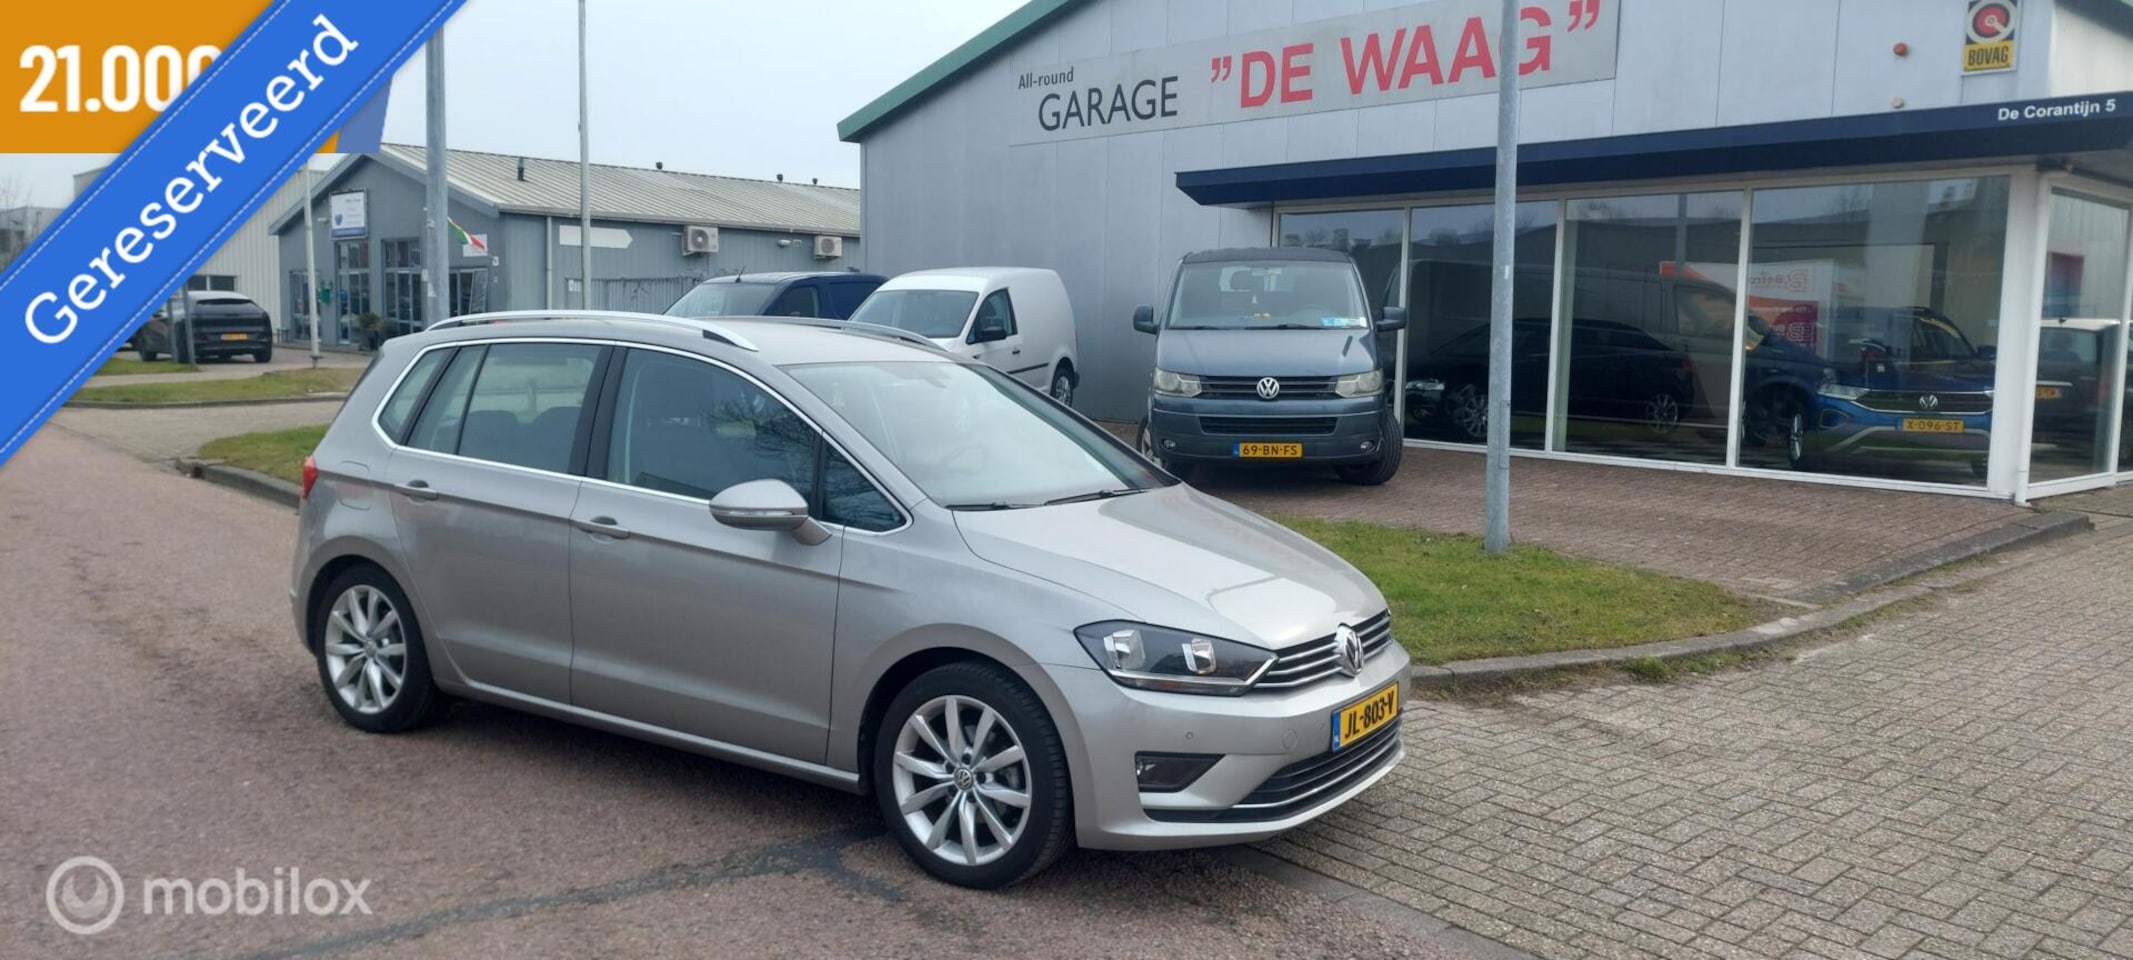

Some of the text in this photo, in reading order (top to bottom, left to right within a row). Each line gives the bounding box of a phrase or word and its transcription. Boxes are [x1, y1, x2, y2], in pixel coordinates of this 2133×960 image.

[1967, 45, 2010, 67] BOVAG
[1018, 66, 1075, 90] All-round
[1038, 76, 1179, 132] GARAGE
[1998, 98, 2117, 121] De Corantijn 5
[1906, 420, 1960, 432] X-096-ST
[1242, 444, 1298, 456] 69-BN-FS
[1344, 689, 1395, 739] JL-803-V
